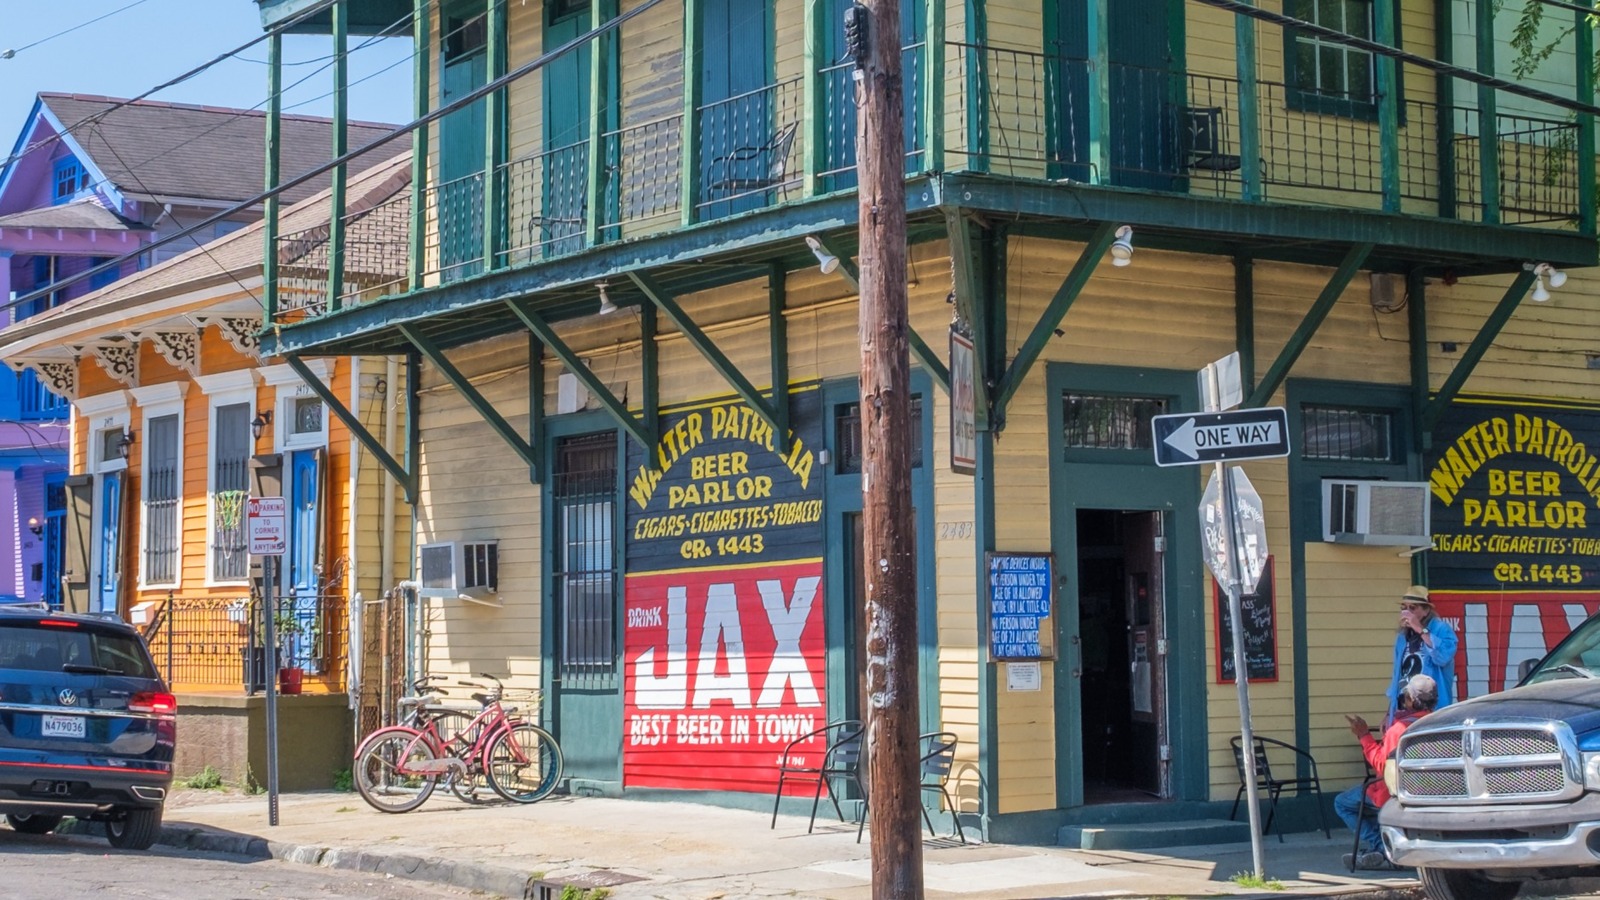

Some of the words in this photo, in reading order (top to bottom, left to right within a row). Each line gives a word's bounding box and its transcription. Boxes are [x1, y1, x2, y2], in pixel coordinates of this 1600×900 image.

[711, 405, 814, 490] PATRIA
[1194, 427, 1231, 447] ONE
[1236, 424, 1272, 444] WAY
[691, 451, 748, 480] BEER
[1429, 417, 1512, 507] WALTER
[668, 475, 773, 509] PARLOR
[1488, 469, 1562, 496] BEER
[248, 502, 259, 514] NO
[260, 503, 284, 511] PARKING
[1463, 498, 1587, 529] PARLOR
[254, 527, 279, 535] CORNER
[717, 533, 765, 556] 1443
[628, 606, 662, 628] DRINK
[634, 576, 822, 710] JAX
[630, 714, 671, 746] BEST
[676, 714, 724, 745] BEER
[730, 714, 750, 744] IN
[755, 713, 815, 744] TOWN
